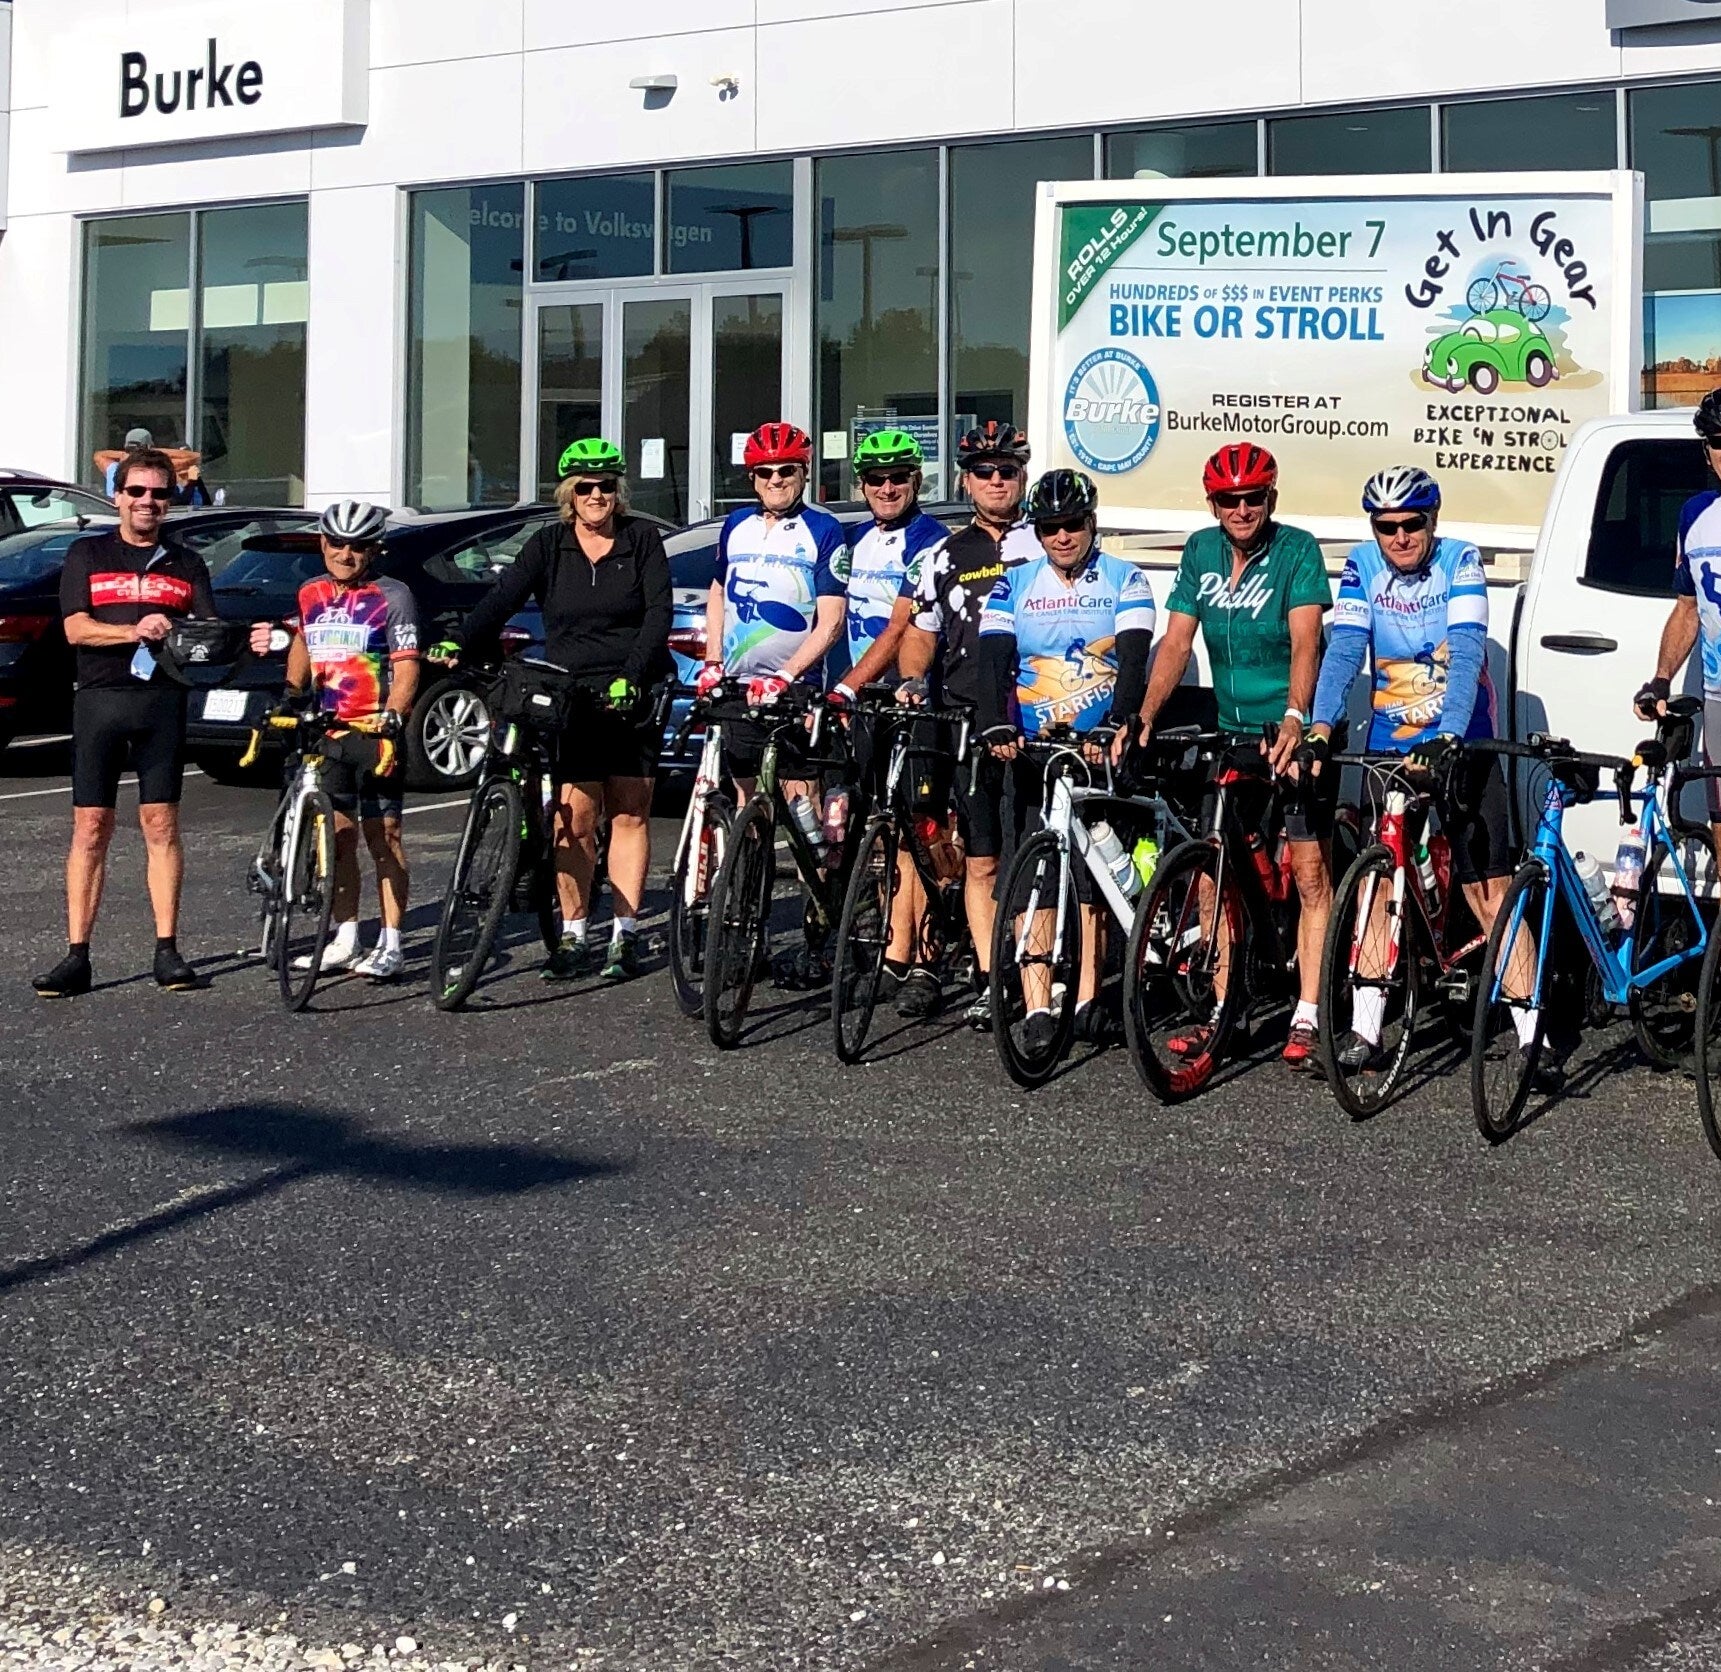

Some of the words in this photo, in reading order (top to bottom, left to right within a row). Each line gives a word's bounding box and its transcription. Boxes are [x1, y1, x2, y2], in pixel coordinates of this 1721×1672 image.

[119, 38, 263, 118] Burke
[469, 201, 549, 232] elcoe
[556, 211, 577, 234] to
[586, 209, 713, 247] Volkswgen
[1066, 265, 1097, 305] OVER
[1095, 247, 1112, 264] 12
[1110, 206, 1148, 250] Hours!
[1067, 207, 1128, 282] ROLLS
[1157, 221, 1352, 265] September
[1365, 220, 1386, 258] 7
[1405, 229, 1461, 308] Get
[1469, 207, 1512, 242] In
[1530, 211, 1597, 310] Gear
[1109, 283, 1199, 301] HUNDREDS
[1203, 288, 1217, 299] OF
[1221, 284, 1248, 303] $$$
[1253, 288, 1264, 300] IN
[1269, 285, 1323, 302] EVENT
[1328, 286, 1383, 303] PERKS
[1110, 304, 1182, 338] BIKE
[1193, 305, 1243, 339] OR
[1254, 305, 1385, 341] STROLL
[1077, 353, 1103, 375] BETTER
[1104, 351, 1114, 359] AT
[1115, 351, 1141, 371] BURKE
[1065, 398, 1160, 425] Burke
[1212, 393, 1309, 409] REGISTER
[1314, 396, 1341, 409] AT
[1426, 404, 1570, 424] EXCEPTIONAL
[1167, 410, 1388, 440] BurkeMotorGroup.com
[1413, 426, 1463, 446] BIKE
[1504, 430, 1568, 451] STROL
[1097, 461, 1117, 472] CAPE
[1117, 459, 1132, 471] MAY
[1132, 435, 1153, 463] COUNTY
[1435, 451, 1556, 473] EXPERIENCE
[958, 563, 1004, 583] cowbell
[1023, 594, 1113, 611] AtlantiCare
[1196, 572, 1275, 619] Philly
[1373, 591, 1448, 615] AtlantiCare
[320, 629, 361, 648] VIRGINIA
[396, 634, 418, 647] VA
